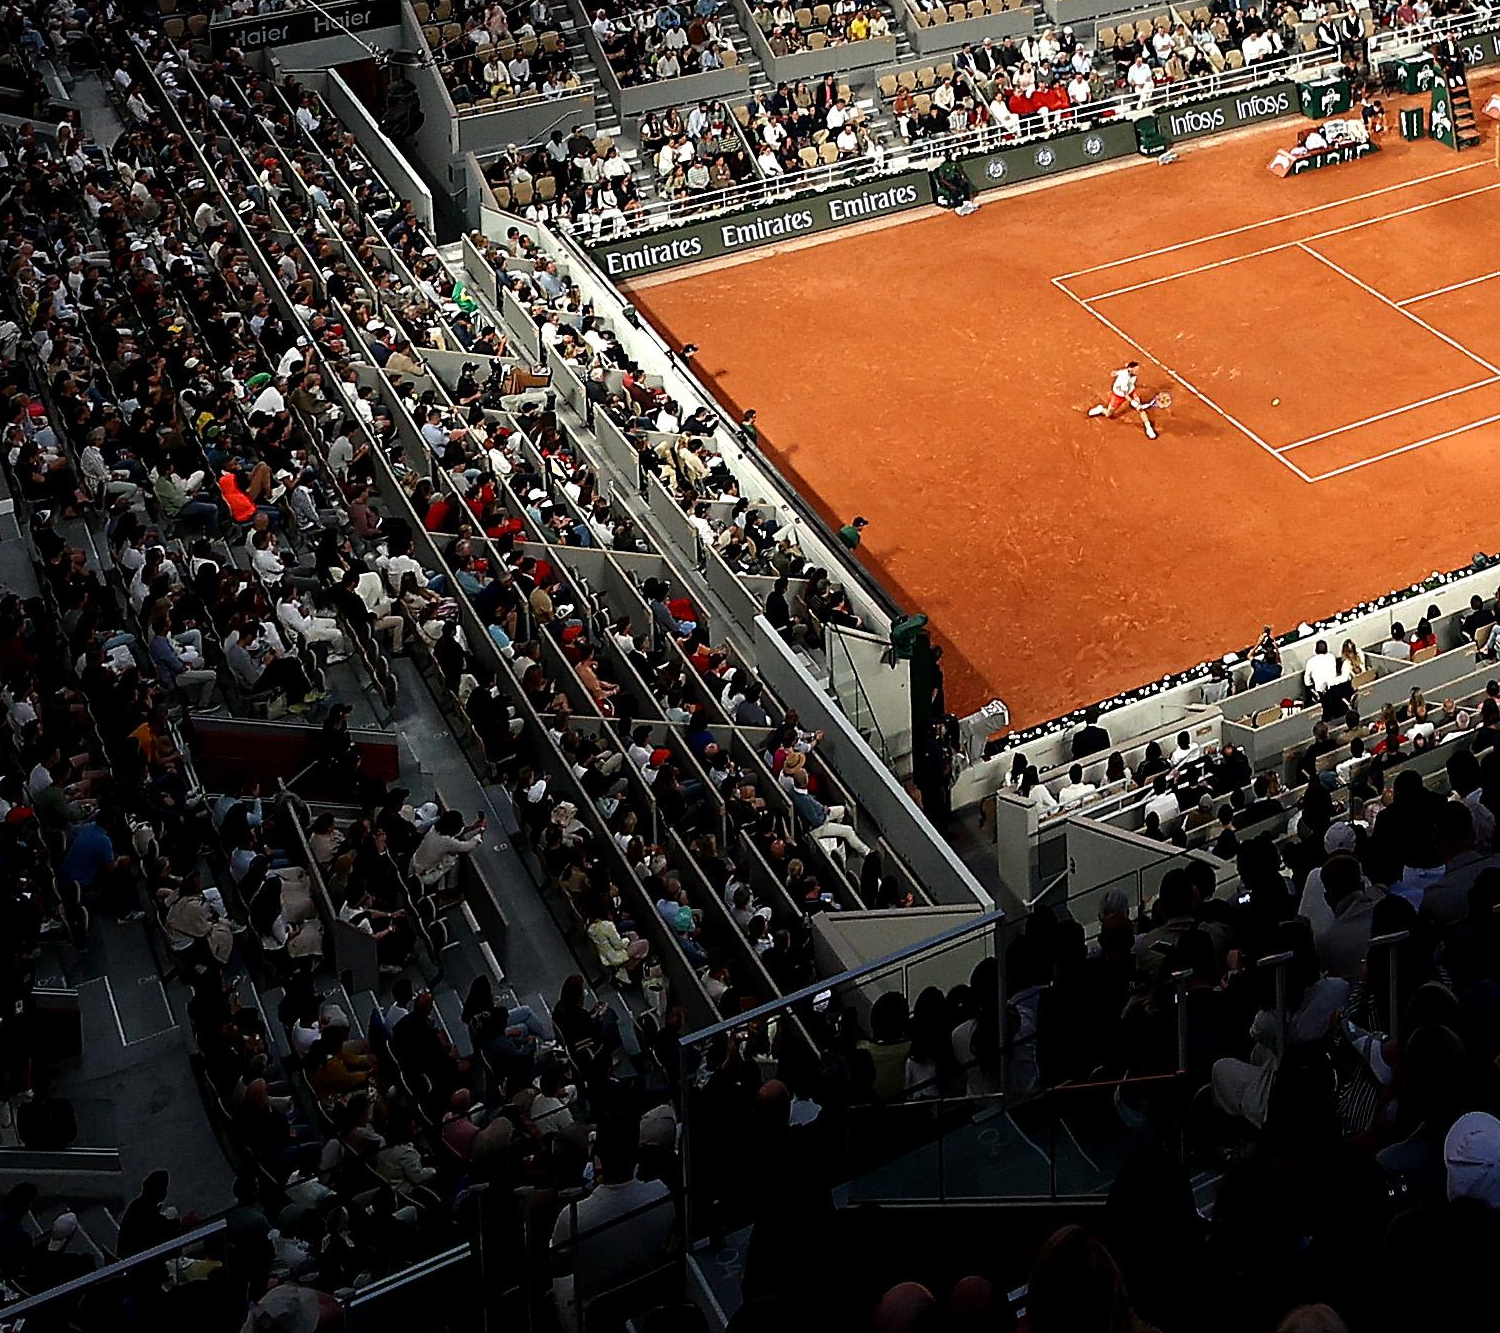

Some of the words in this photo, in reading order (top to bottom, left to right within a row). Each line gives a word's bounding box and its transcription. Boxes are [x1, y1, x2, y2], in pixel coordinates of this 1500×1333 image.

[314, 10, 372, 34] Haier
[1170, 106, 1225, 136] Infosys
[1236, 90, 1289, 121] Infosys
[828, 183, 918, 221] Emirates
[721, 210, 814, 248] Emirates
[605, 236, 703, 276] Emirates
